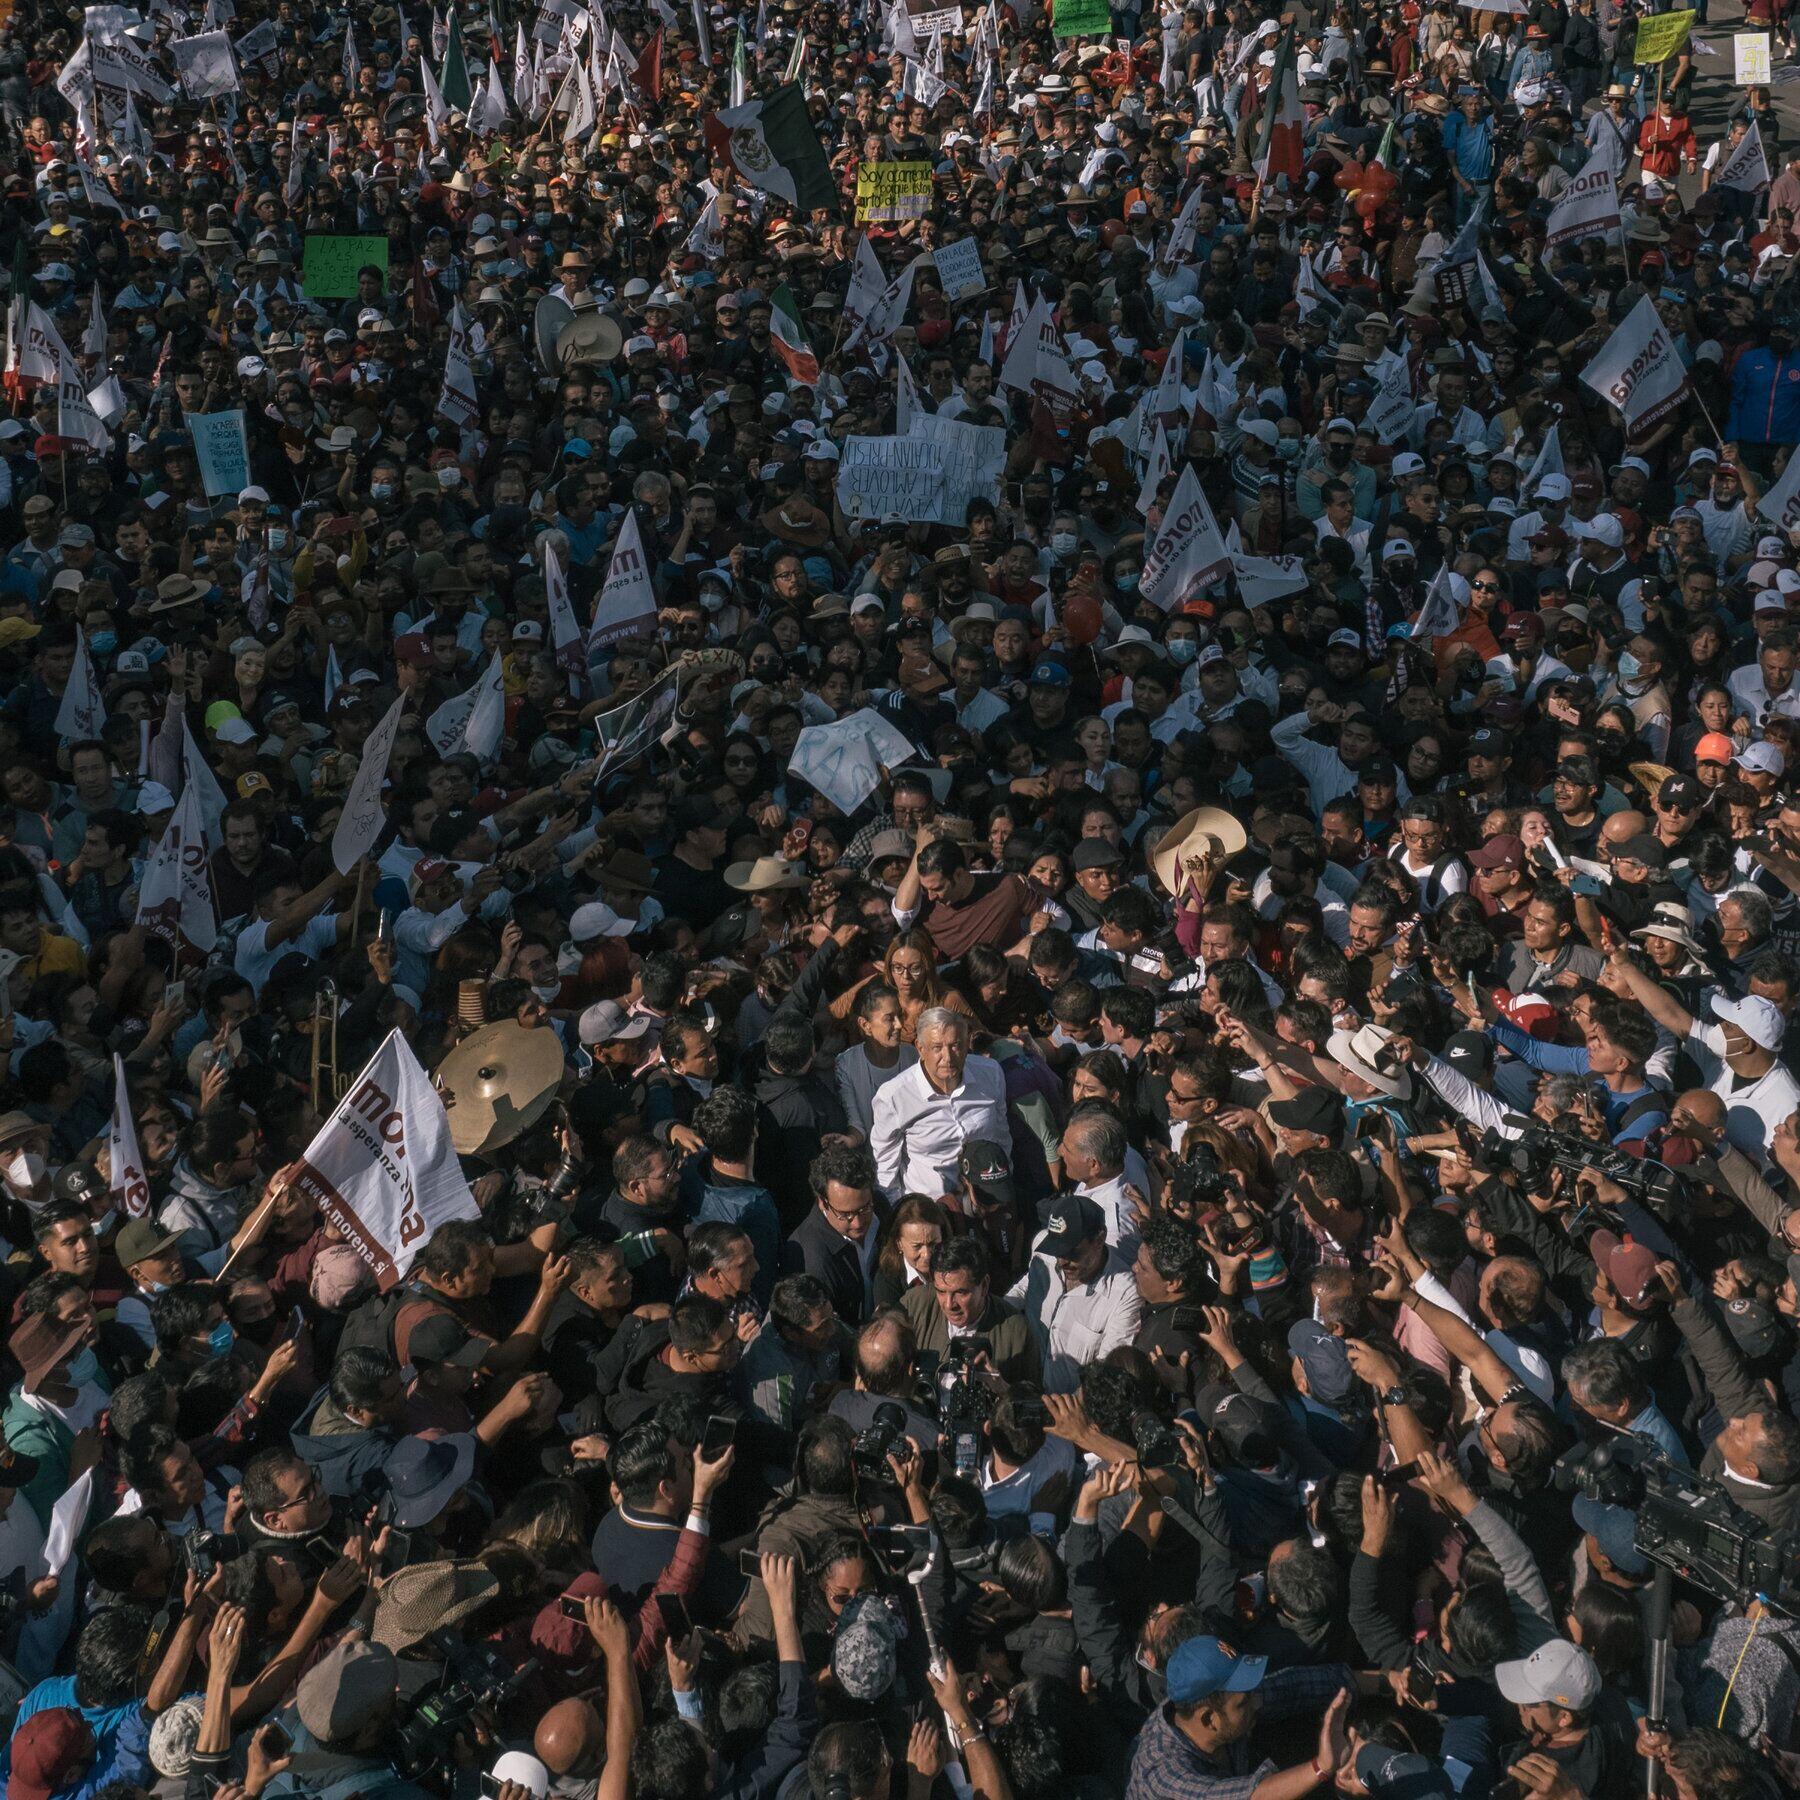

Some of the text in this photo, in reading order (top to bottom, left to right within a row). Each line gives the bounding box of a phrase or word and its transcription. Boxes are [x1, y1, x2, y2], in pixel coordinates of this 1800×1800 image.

[538, 8, 583, 39] morna
[1142, 946, 1165, 959] more
[337, 1107, 402, 1184] La esperanza
[348, 1077, 426, 1250] morna
[299, 1174, 391, 1278] www.morena.si
